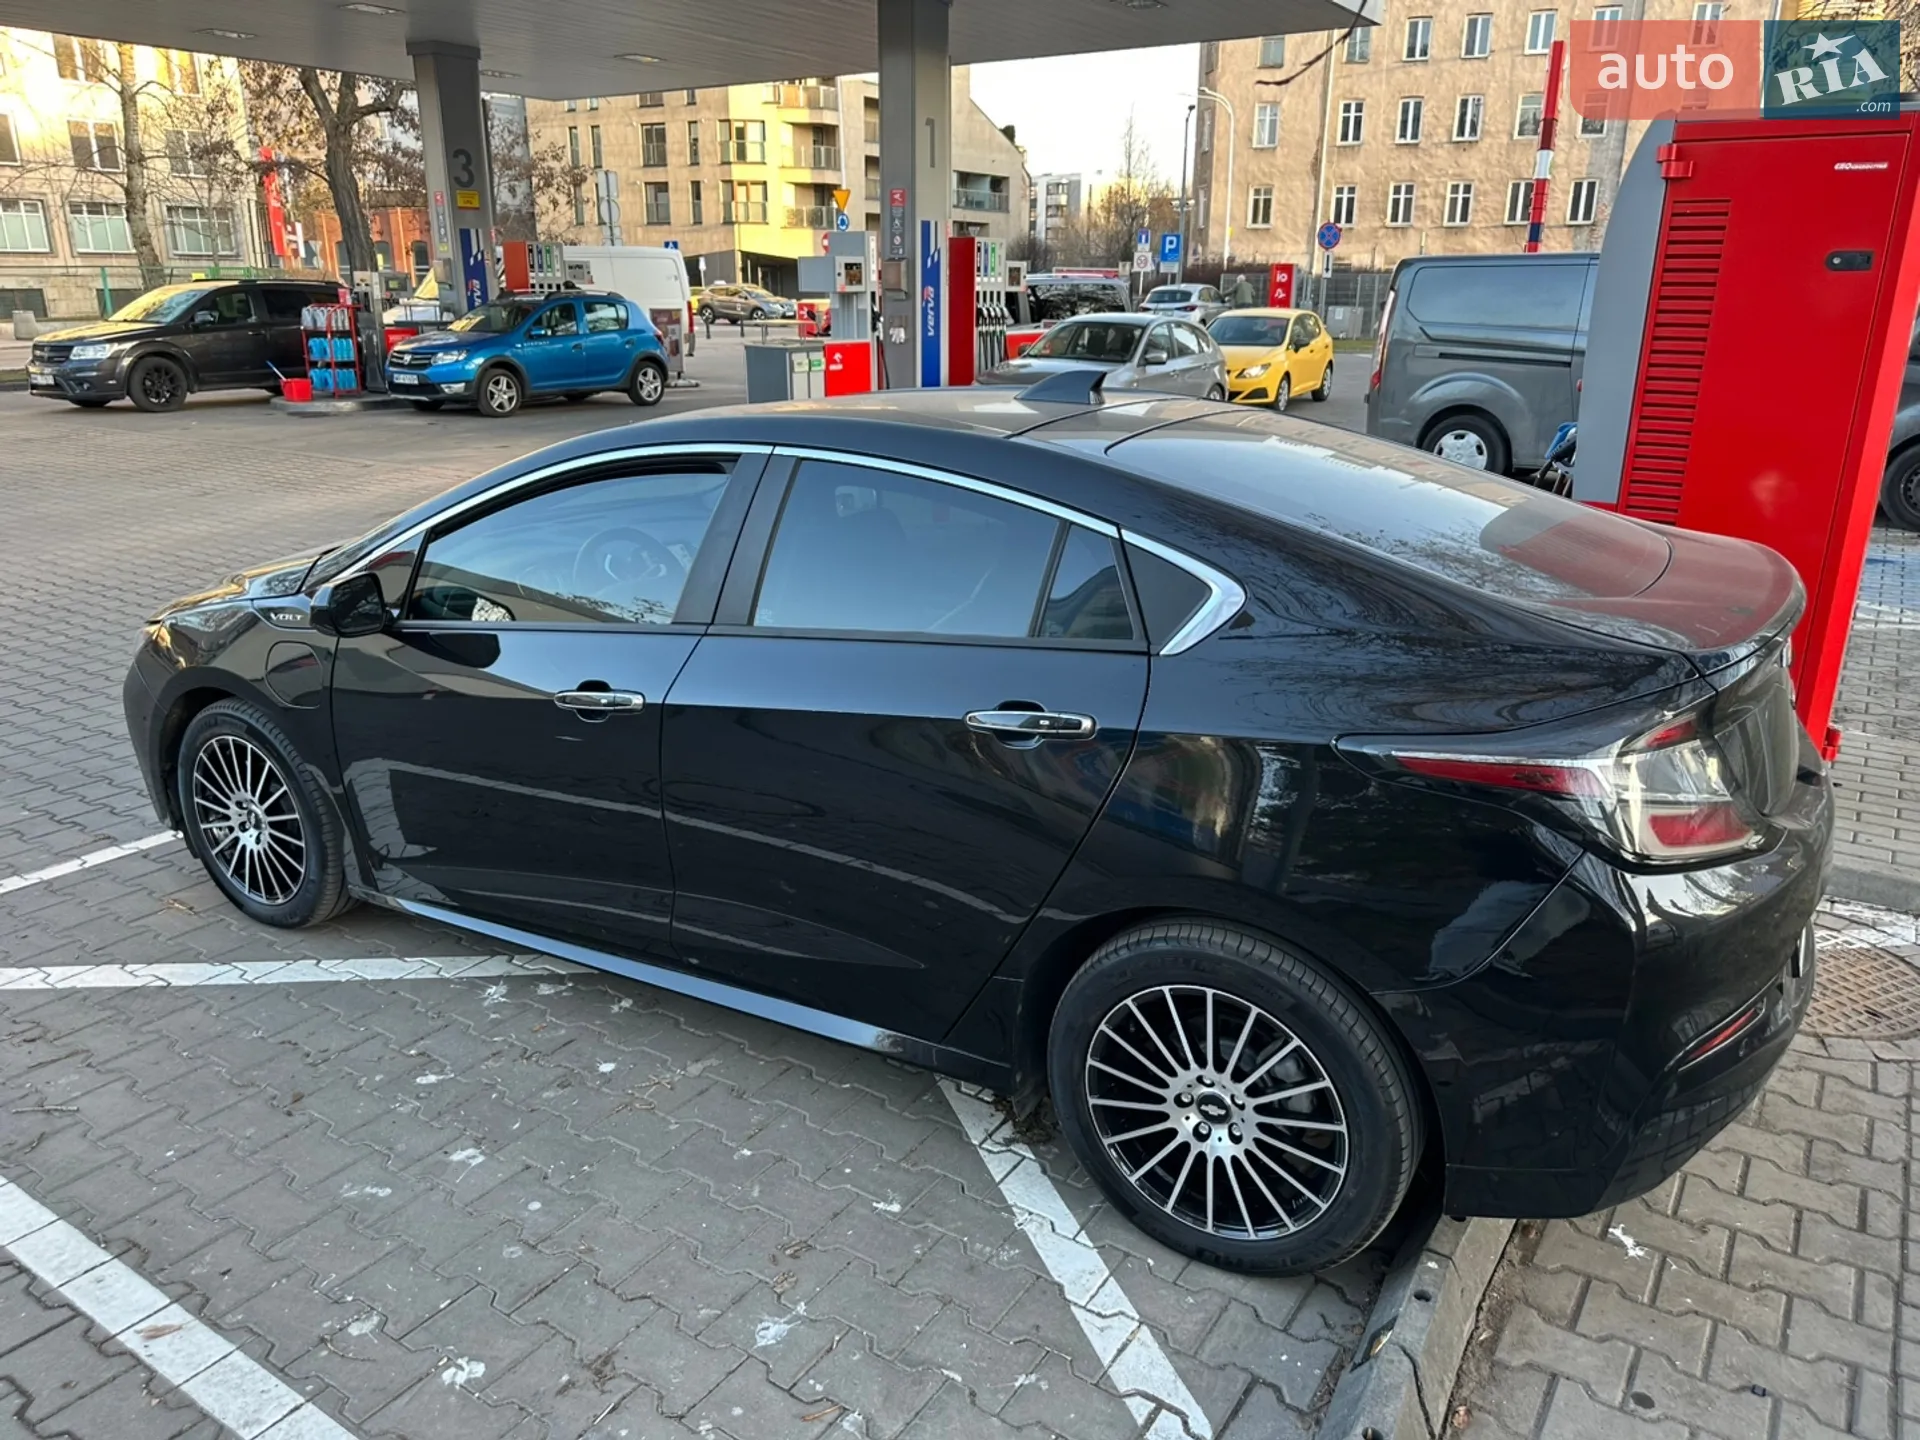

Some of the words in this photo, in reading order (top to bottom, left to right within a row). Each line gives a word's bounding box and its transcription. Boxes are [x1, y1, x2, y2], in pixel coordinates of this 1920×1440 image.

[925, 117, 935, 168] 1
[452, 148, 475, 188] 3
[1165, 236, 1177, 253] P
[925, 285, 935, 336] verva
[270, 612, 304, 621] VOLT
